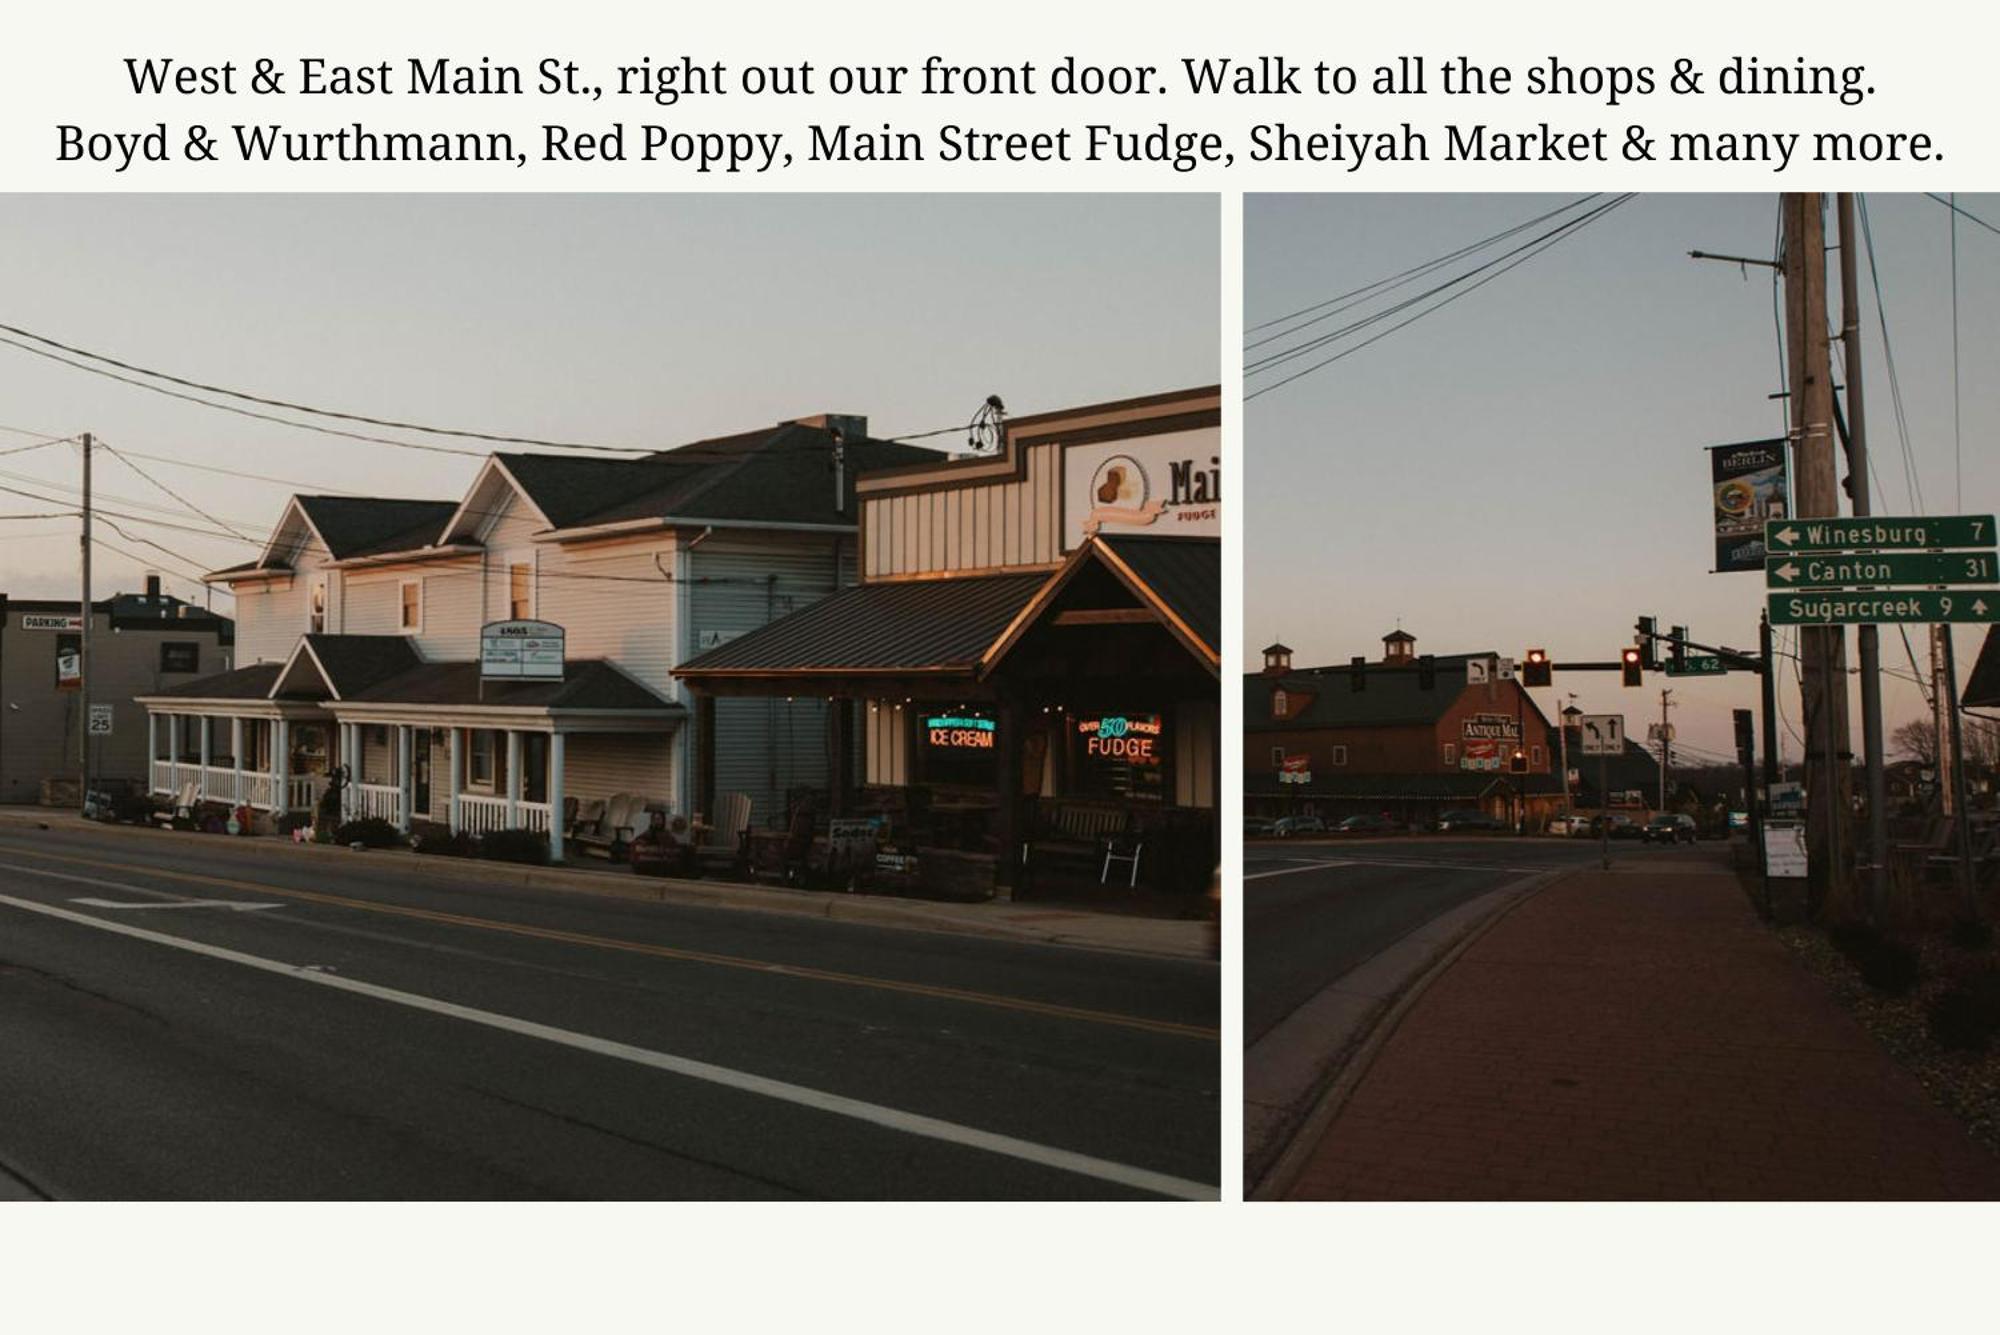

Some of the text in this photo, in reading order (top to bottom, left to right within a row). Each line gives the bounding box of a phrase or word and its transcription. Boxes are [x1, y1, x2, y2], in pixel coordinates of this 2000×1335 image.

[1722, 454, 1775, 468] BERLIN
[1177, 510, 1217, 521] FUDGE
[1807, 522, 1984, 546] Winesburg 7
[1808, 558, 1987, 581] Canton 31
[1789, 596, 1952, 622] Sugarcreek 9
[26, 617, 67, 628] PARKING
[1701, 658, 1720, 671] 62
[92, 719, 110, 731] 25
[1097, 716, 1129, 738] 50
[1465, 722, 1520, 738] ANTIQUE MAL
[930, 729, 993, 748] ICE CREAM
[1088, 737, 1153, 757] FUDGE
